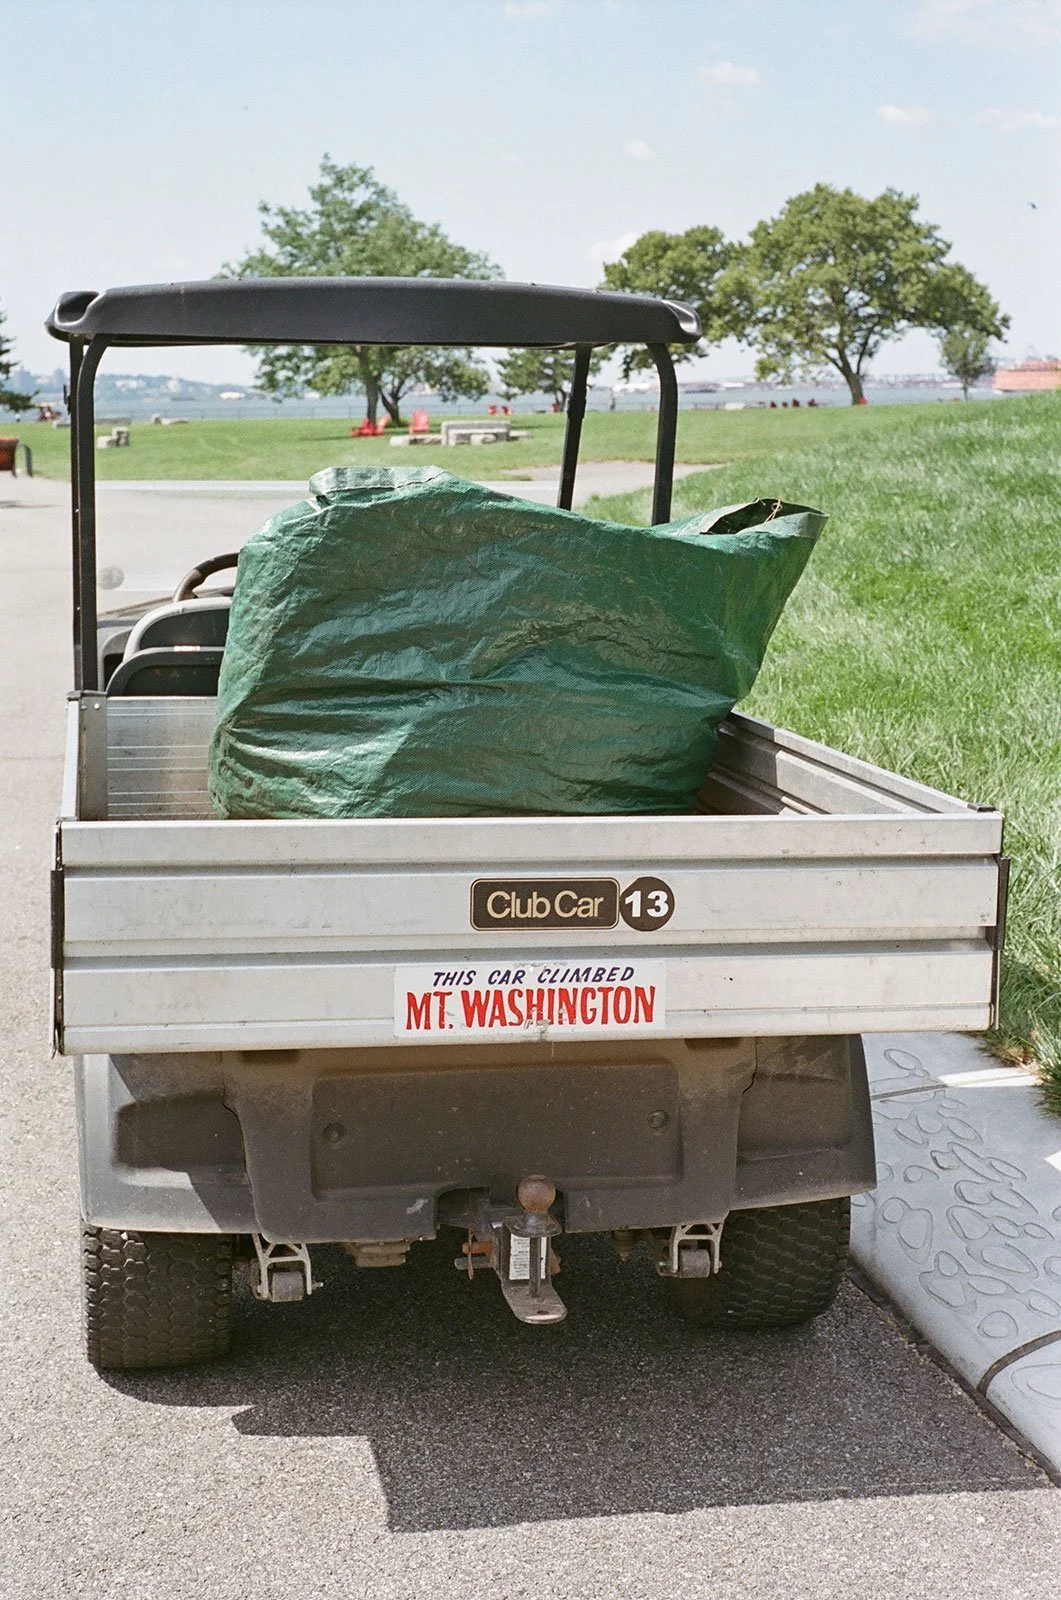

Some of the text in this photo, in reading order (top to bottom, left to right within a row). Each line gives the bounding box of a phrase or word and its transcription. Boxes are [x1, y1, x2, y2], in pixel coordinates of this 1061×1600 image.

[486, 890, 604, 919] Club Car
[624, 890, 669, 918] 13
[433, 966, 635, 987] THIS CAR CLIMBED
[405, 985, 656, 1030] MT. WASHINGTON
